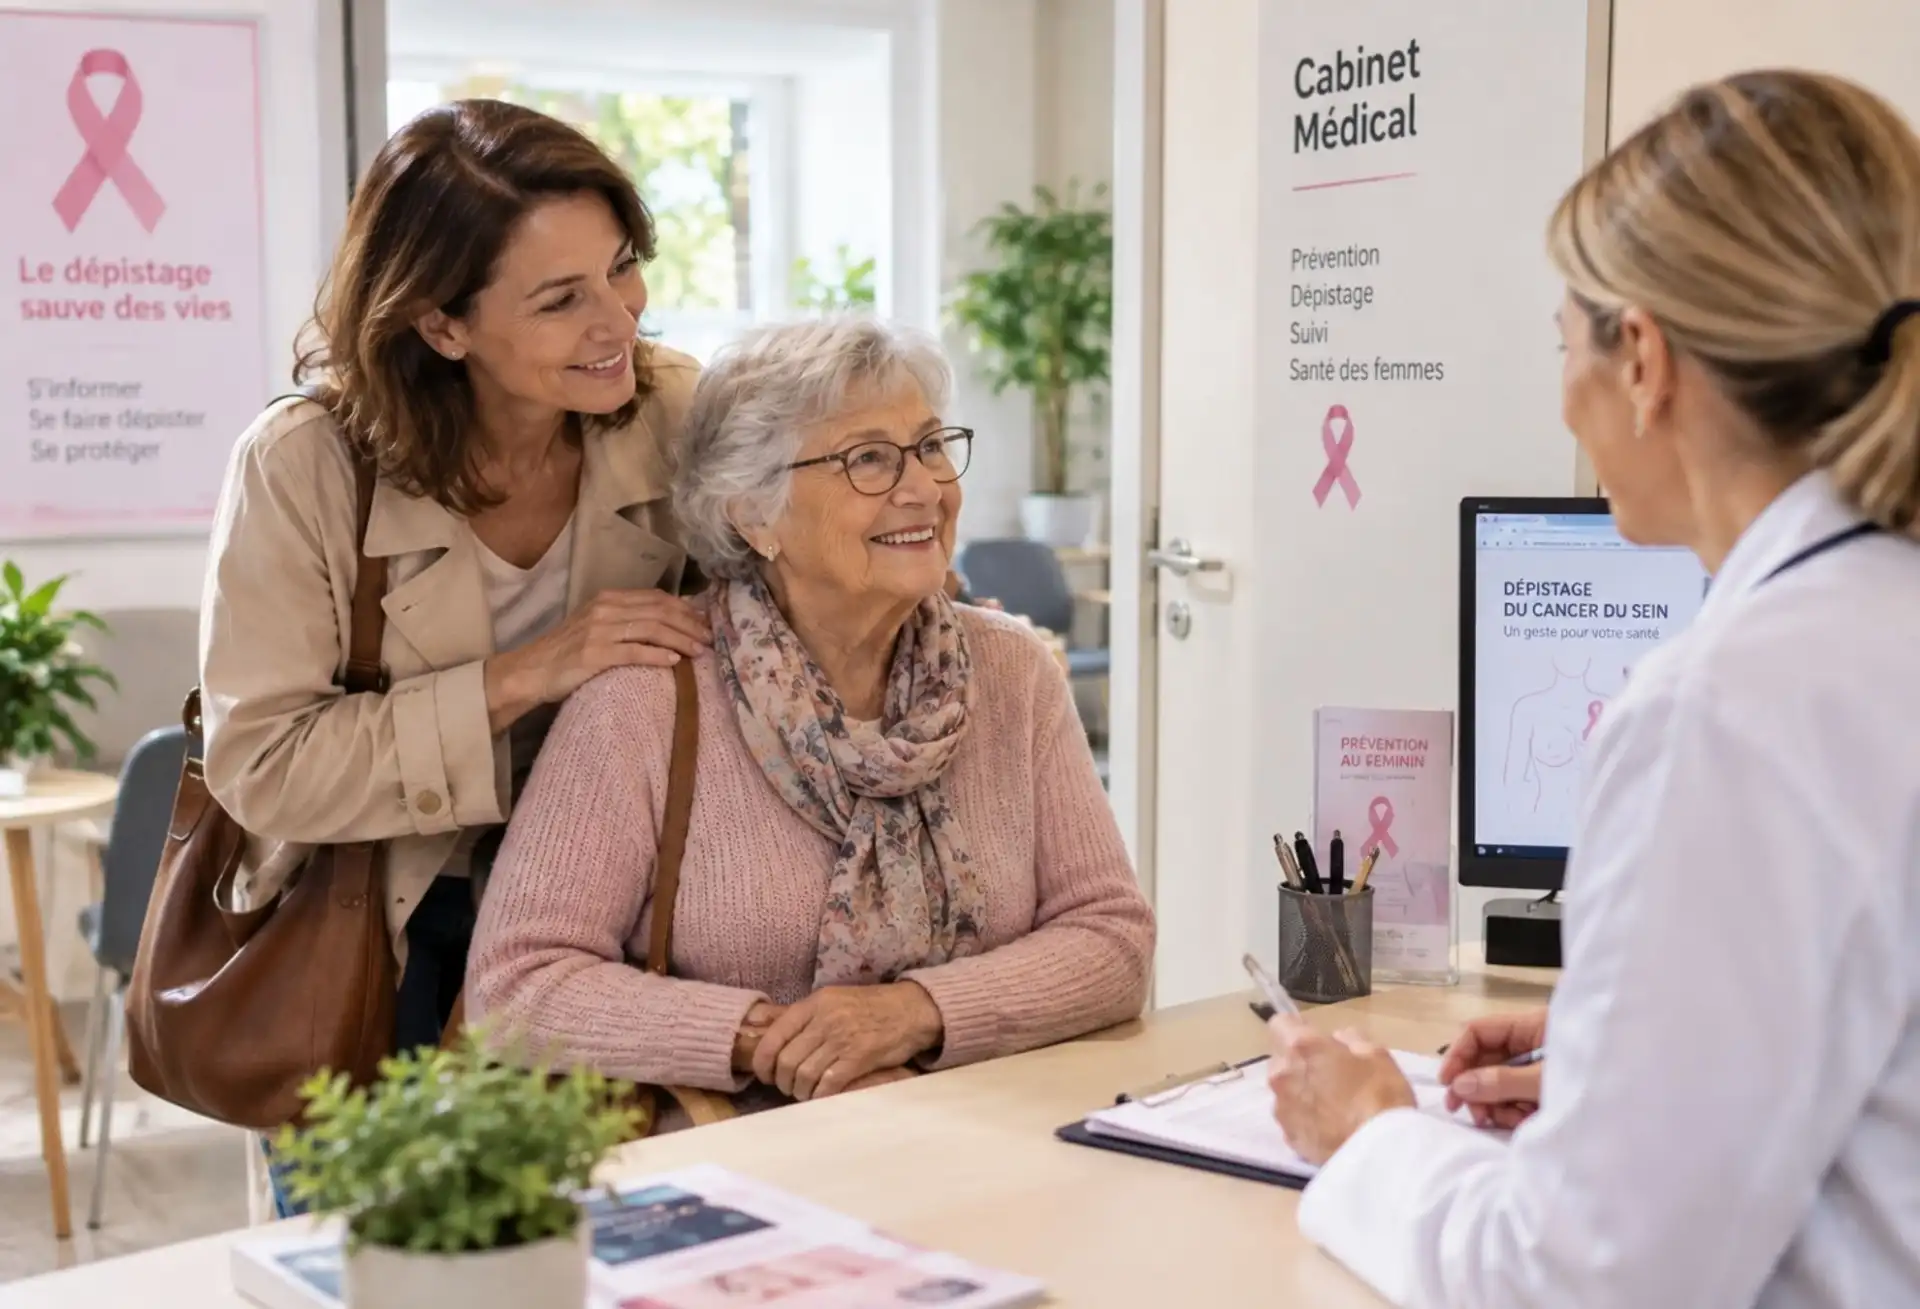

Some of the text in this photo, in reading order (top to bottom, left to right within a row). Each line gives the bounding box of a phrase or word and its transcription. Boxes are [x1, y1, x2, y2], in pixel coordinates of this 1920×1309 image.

[1294, 38, 1420, 99] Cabinet
[1294, 93, 1417, 154] Médical
[1291, 244, 1380, 271] Prévention
[19, 256, 212, 291] Le dépistage
[20, 293, 233, 321] sauve des vies
[1291, 283, 1374, 311] Dépistage
[1290, 320, 1329, 344] Suivi
[1290, 356, 1444, 382] Santé des femmes
[27, 377, 142, 400] S'informer
[29, 408, 206, 431] Se faire dépister
[30, 439, 160, 465] Se protéger
[1504, 579, 1593, 597] DÉPISTAGE
[1504, 602, 1668, 619] DU CANCER DU SEIN
[1503, 625, 1660, 640] Un geste pour votre santé
[1340, 733, 1429, 751] PRÉVENTION
[1340, 755, 1361, 767] AU
